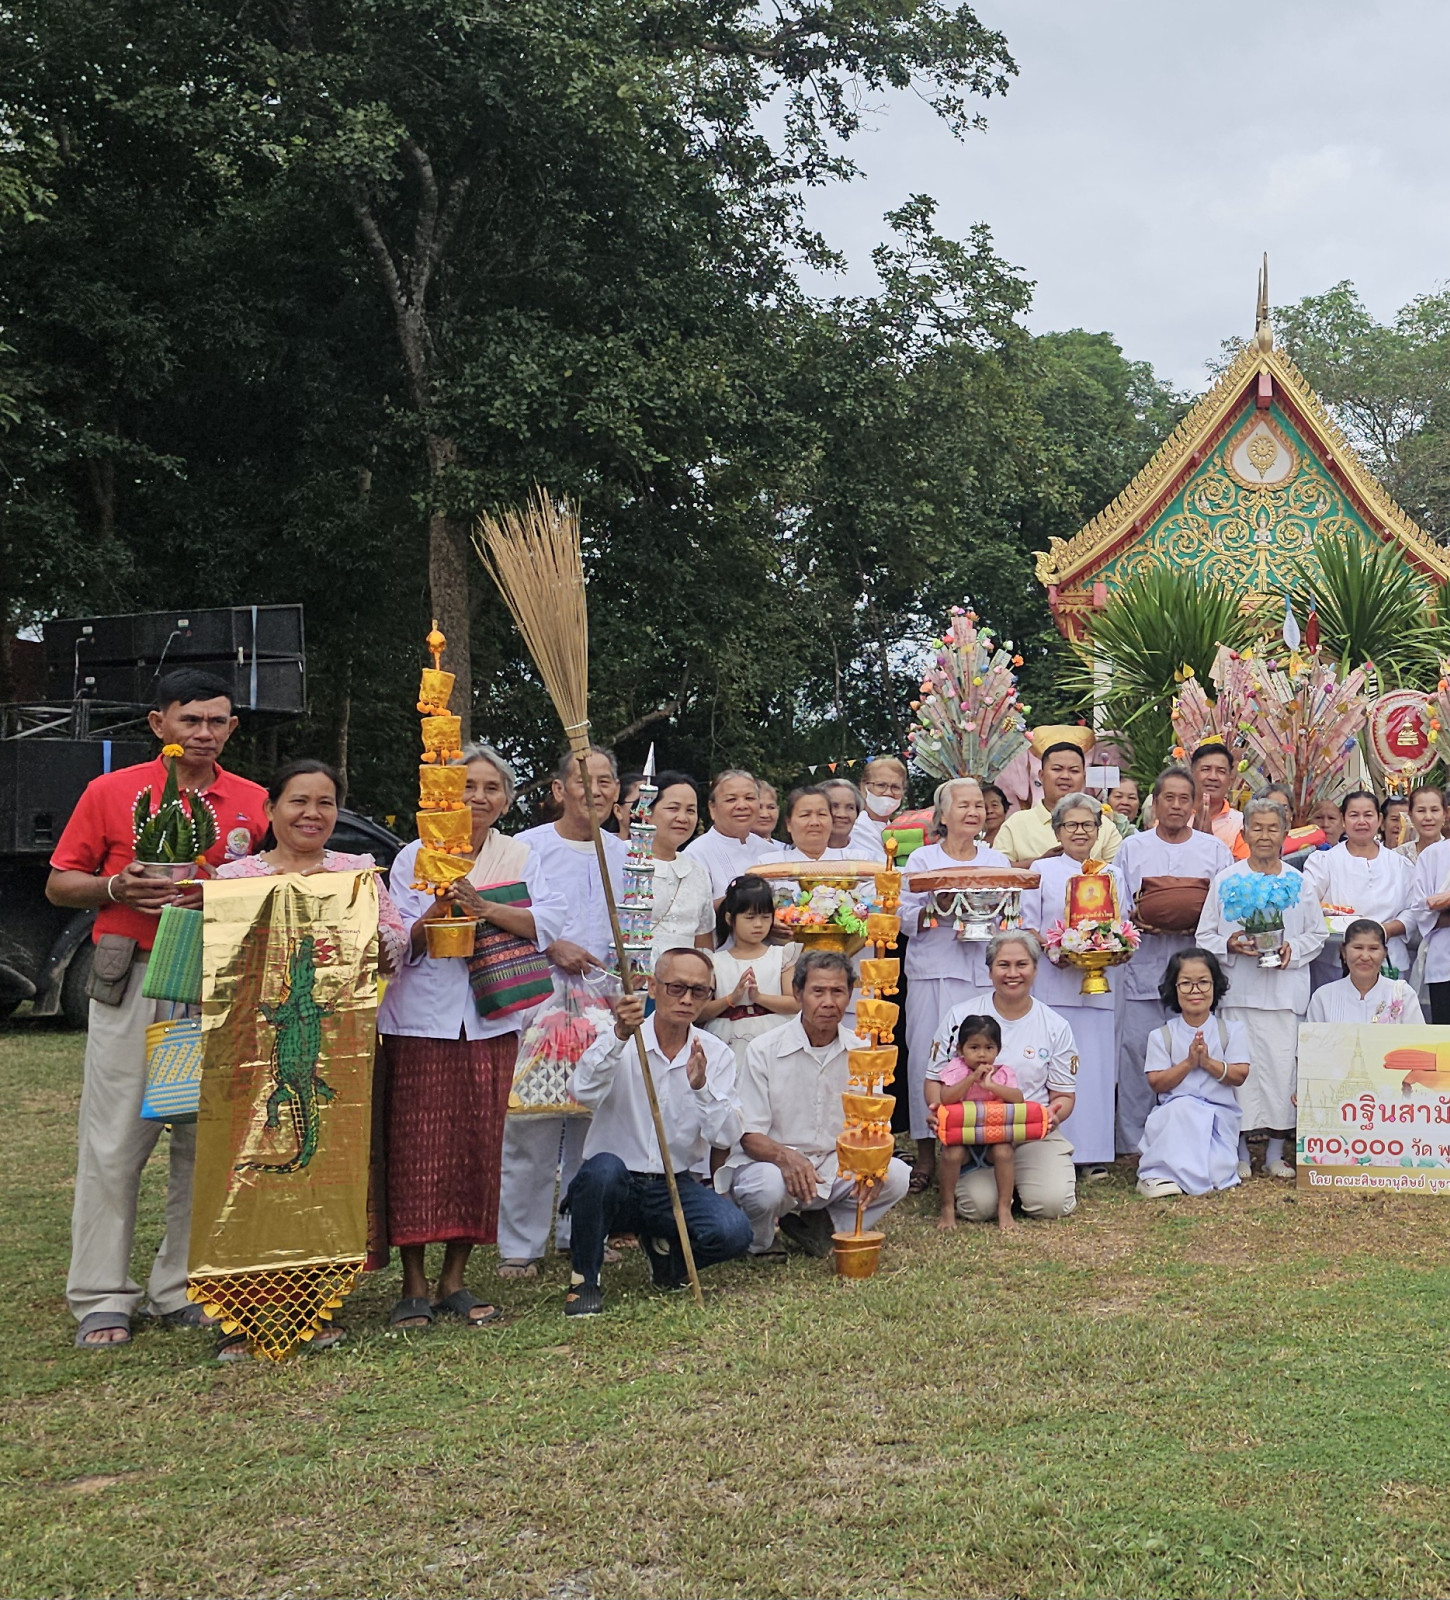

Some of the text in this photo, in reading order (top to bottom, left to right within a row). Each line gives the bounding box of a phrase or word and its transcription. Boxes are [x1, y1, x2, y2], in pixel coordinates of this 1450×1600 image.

[1307, 1137, 1404, 1158] ๓๐,๐๐๐
[1411, 1137, 1432, 1157] วัด
[1309, 1171, 1331, 1186] โดย
[1335, 1173, 1425, 1190] คณะศิษยานุศิษย์
